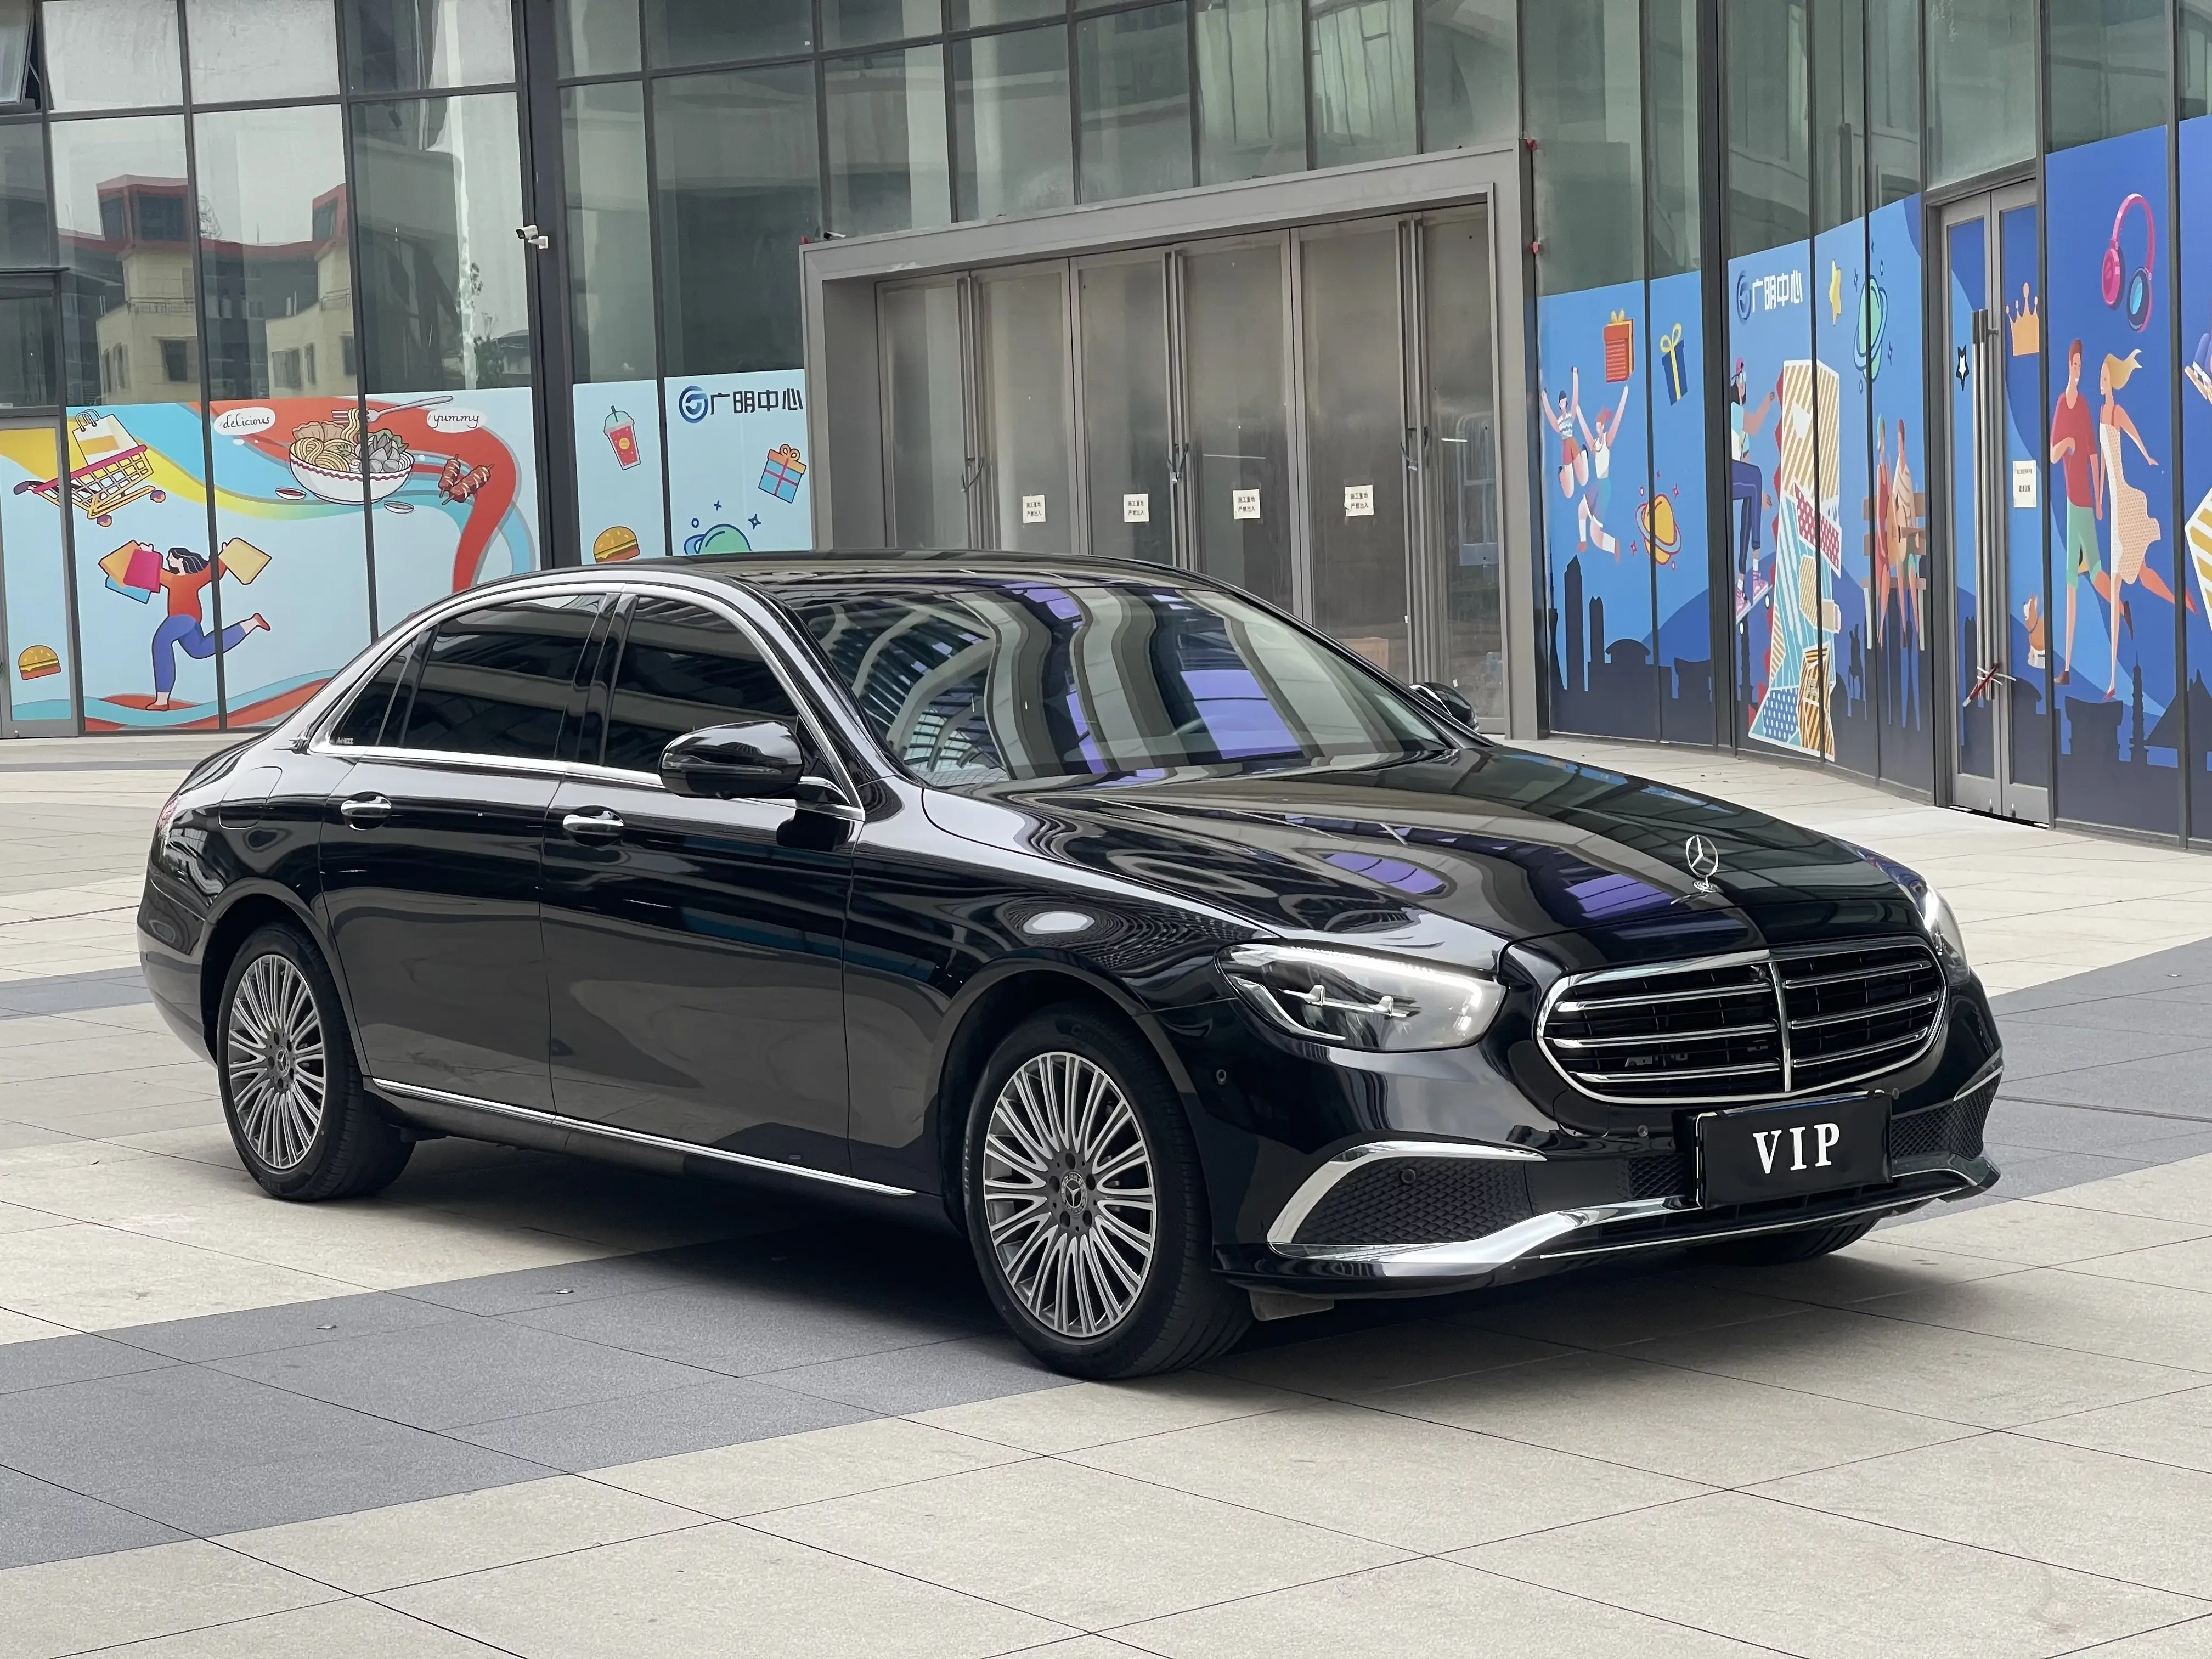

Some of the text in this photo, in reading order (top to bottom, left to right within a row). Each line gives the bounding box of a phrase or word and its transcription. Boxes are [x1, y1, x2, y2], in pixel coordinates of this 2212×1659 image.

[1752, 270, 1803, 313] 广明中心
[710, 388, 803, 415] 广明中心
[223, 413, 270, 428] delicious
[432, 415, 479, 429] yummy
[1753, 1122, 1839, 1174] VIP
